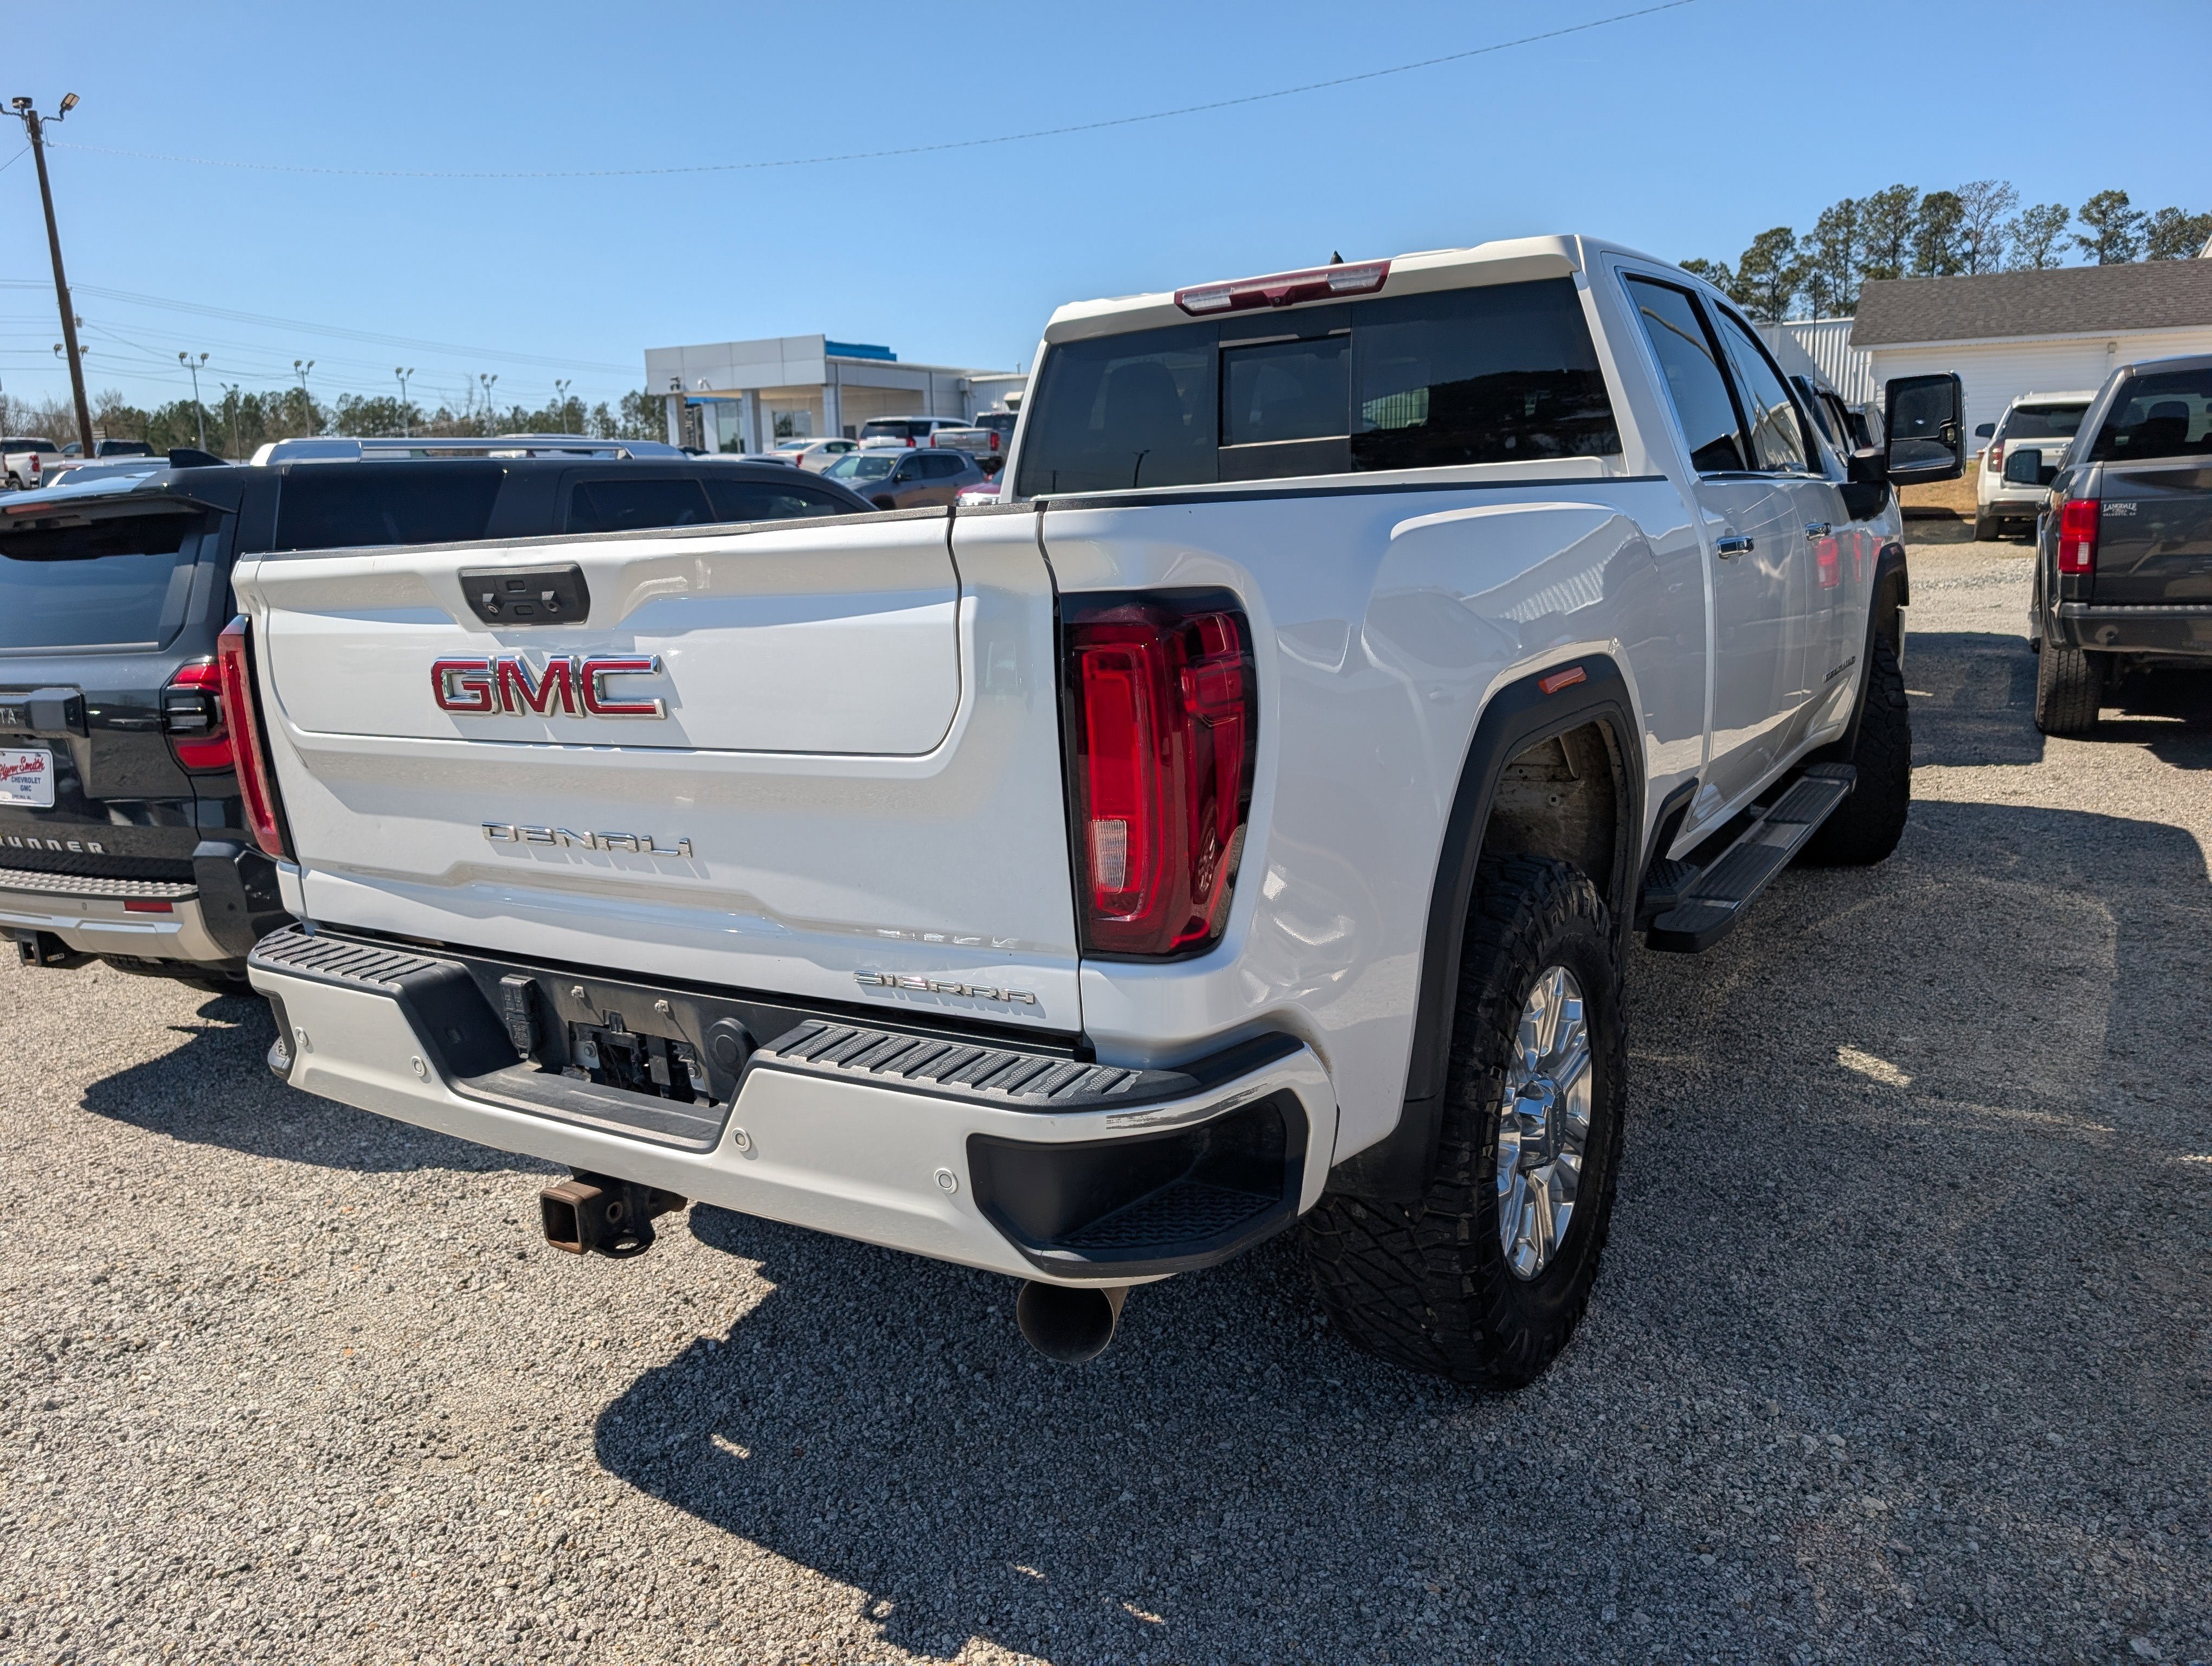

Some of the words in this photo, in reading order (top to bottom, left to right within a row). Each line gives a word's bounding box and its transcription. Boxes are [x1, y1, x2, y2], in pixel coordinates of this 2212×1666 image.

[431, 655, 667, 719] GMC
[11, 776, 41, 784] CHEVROLET
[20, 755, 45, 771] Smith
[482, 822, 692, 858] DENALI
[853, 970, 1035, 1004] SIERRA
